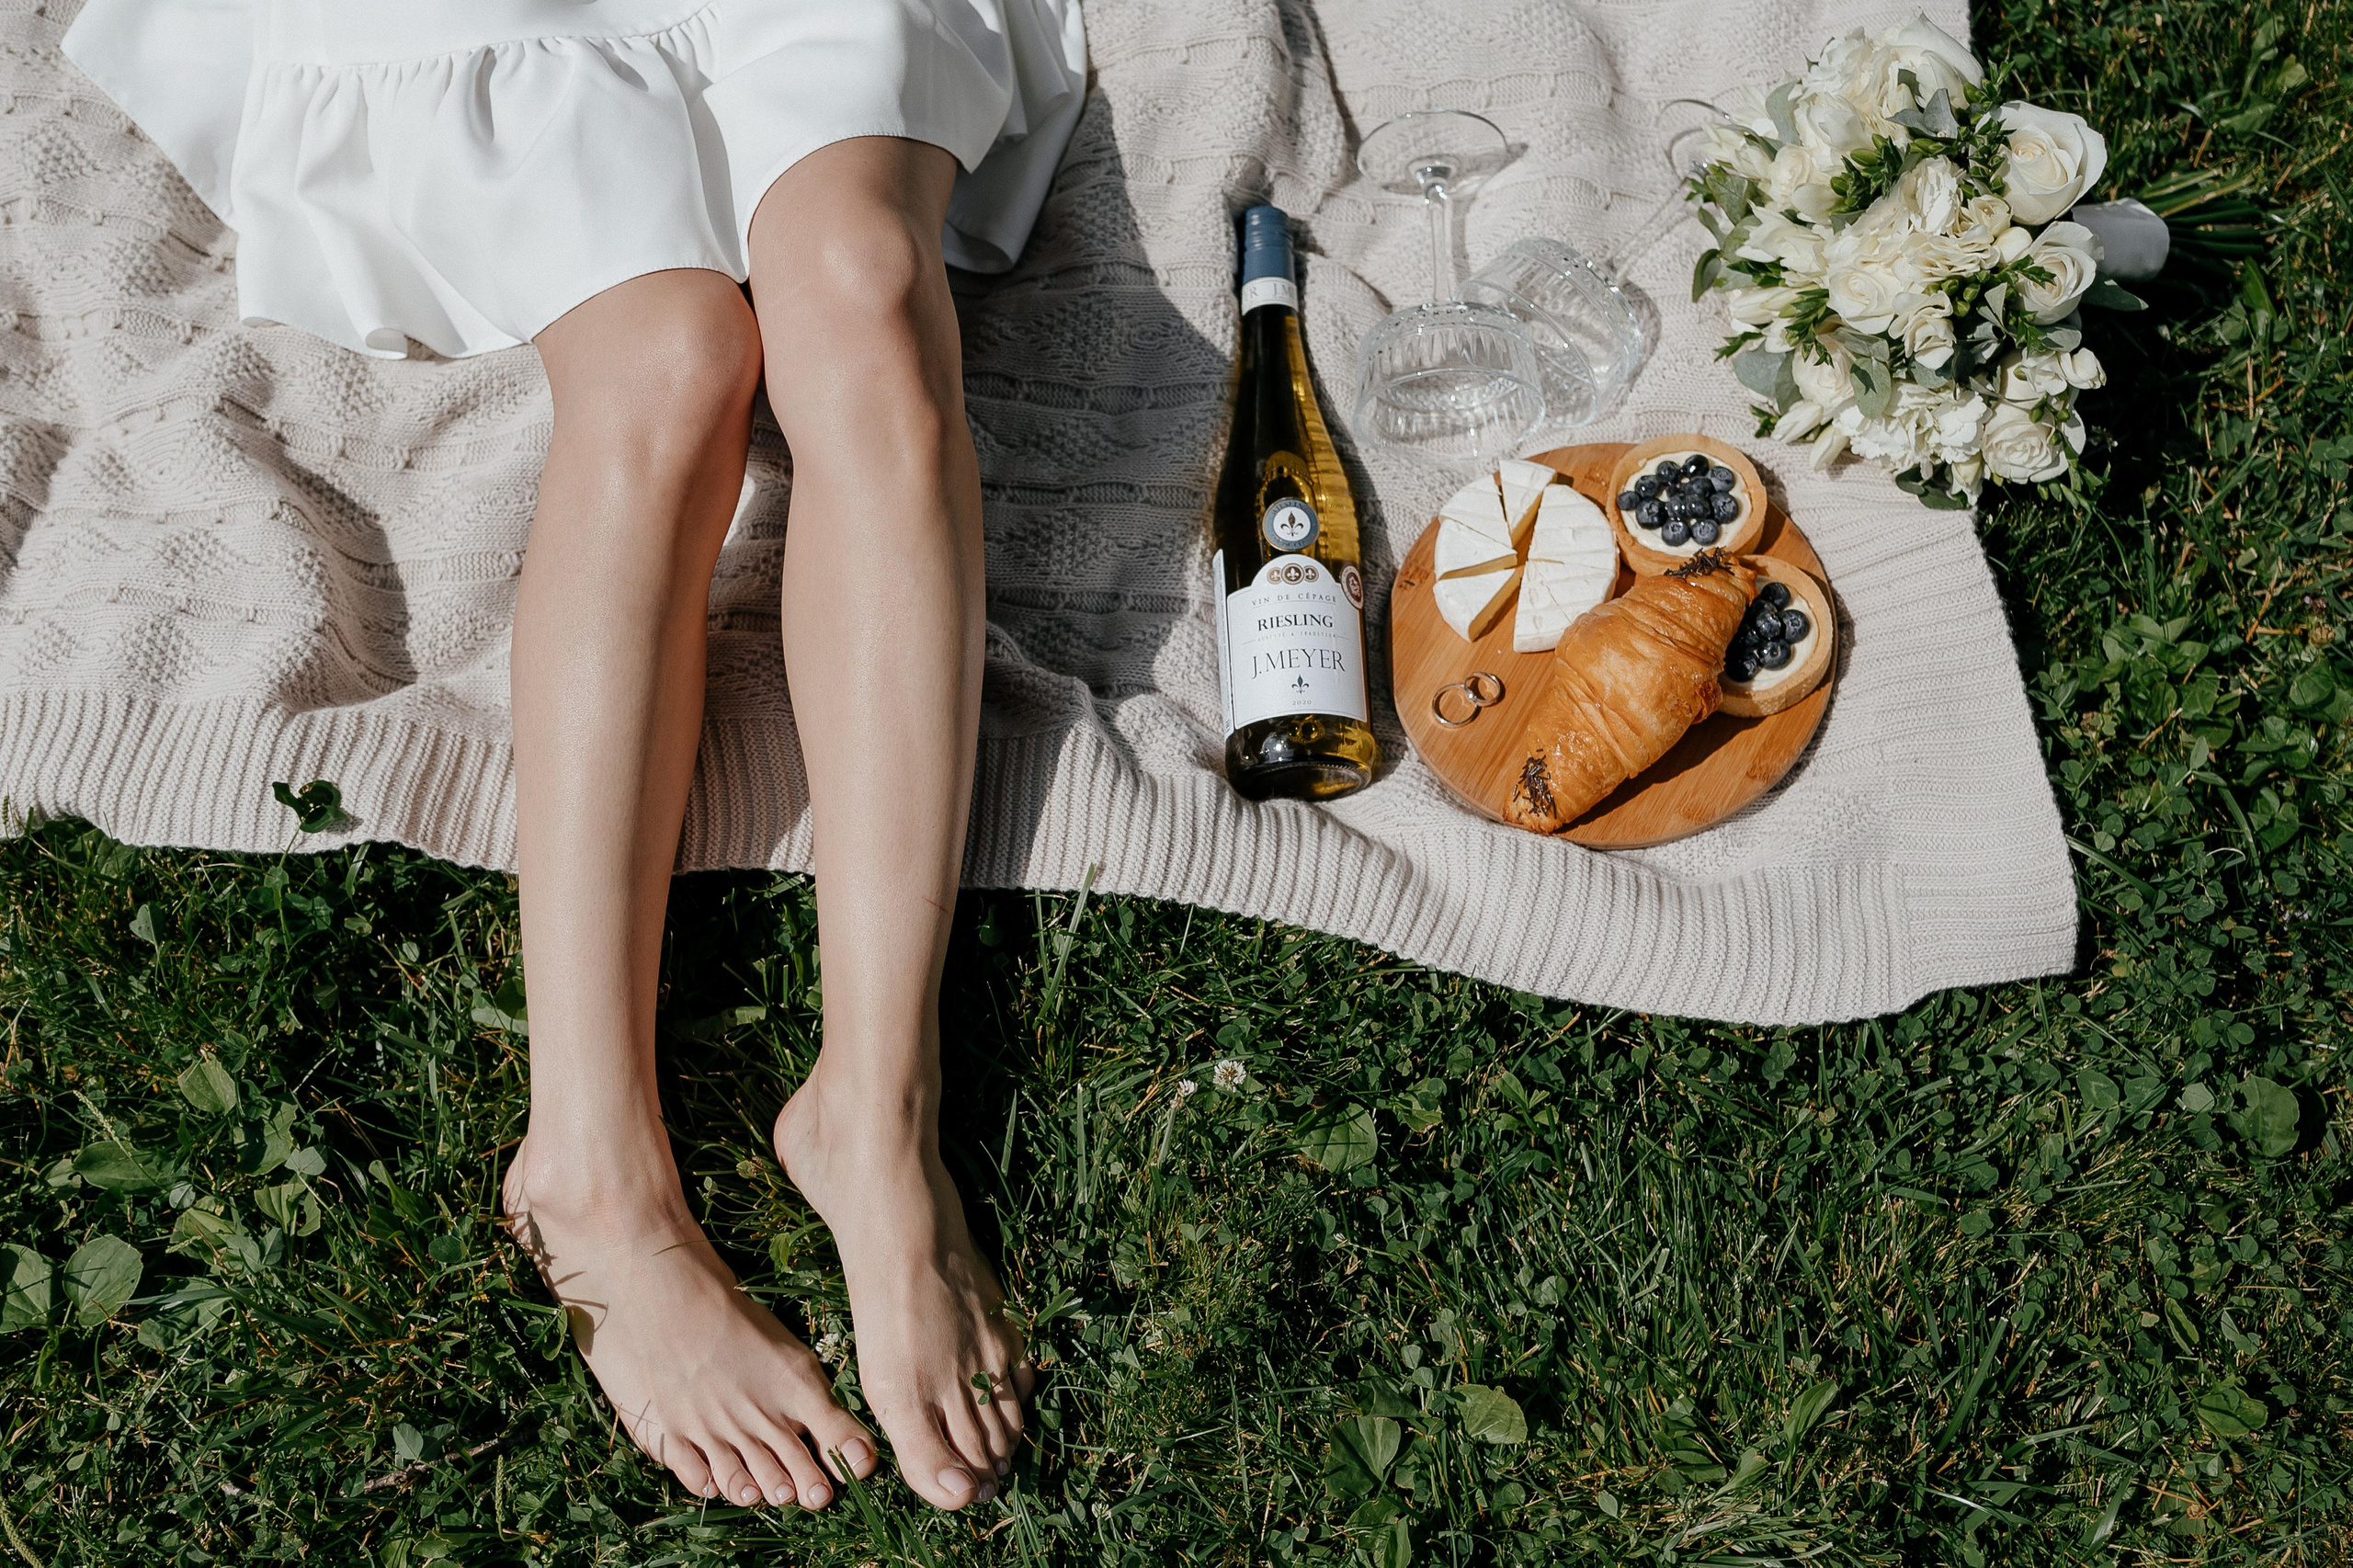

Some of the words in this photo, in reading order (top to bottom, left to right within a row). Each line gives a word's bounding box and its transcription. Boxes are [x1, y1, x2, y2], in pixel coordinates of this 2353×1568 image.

[1252, 597, 1269, 606] VIN
[1298, 592, 1336, 603] CÉPAGE
[1257, 614, 1333, 631] RIESLING
